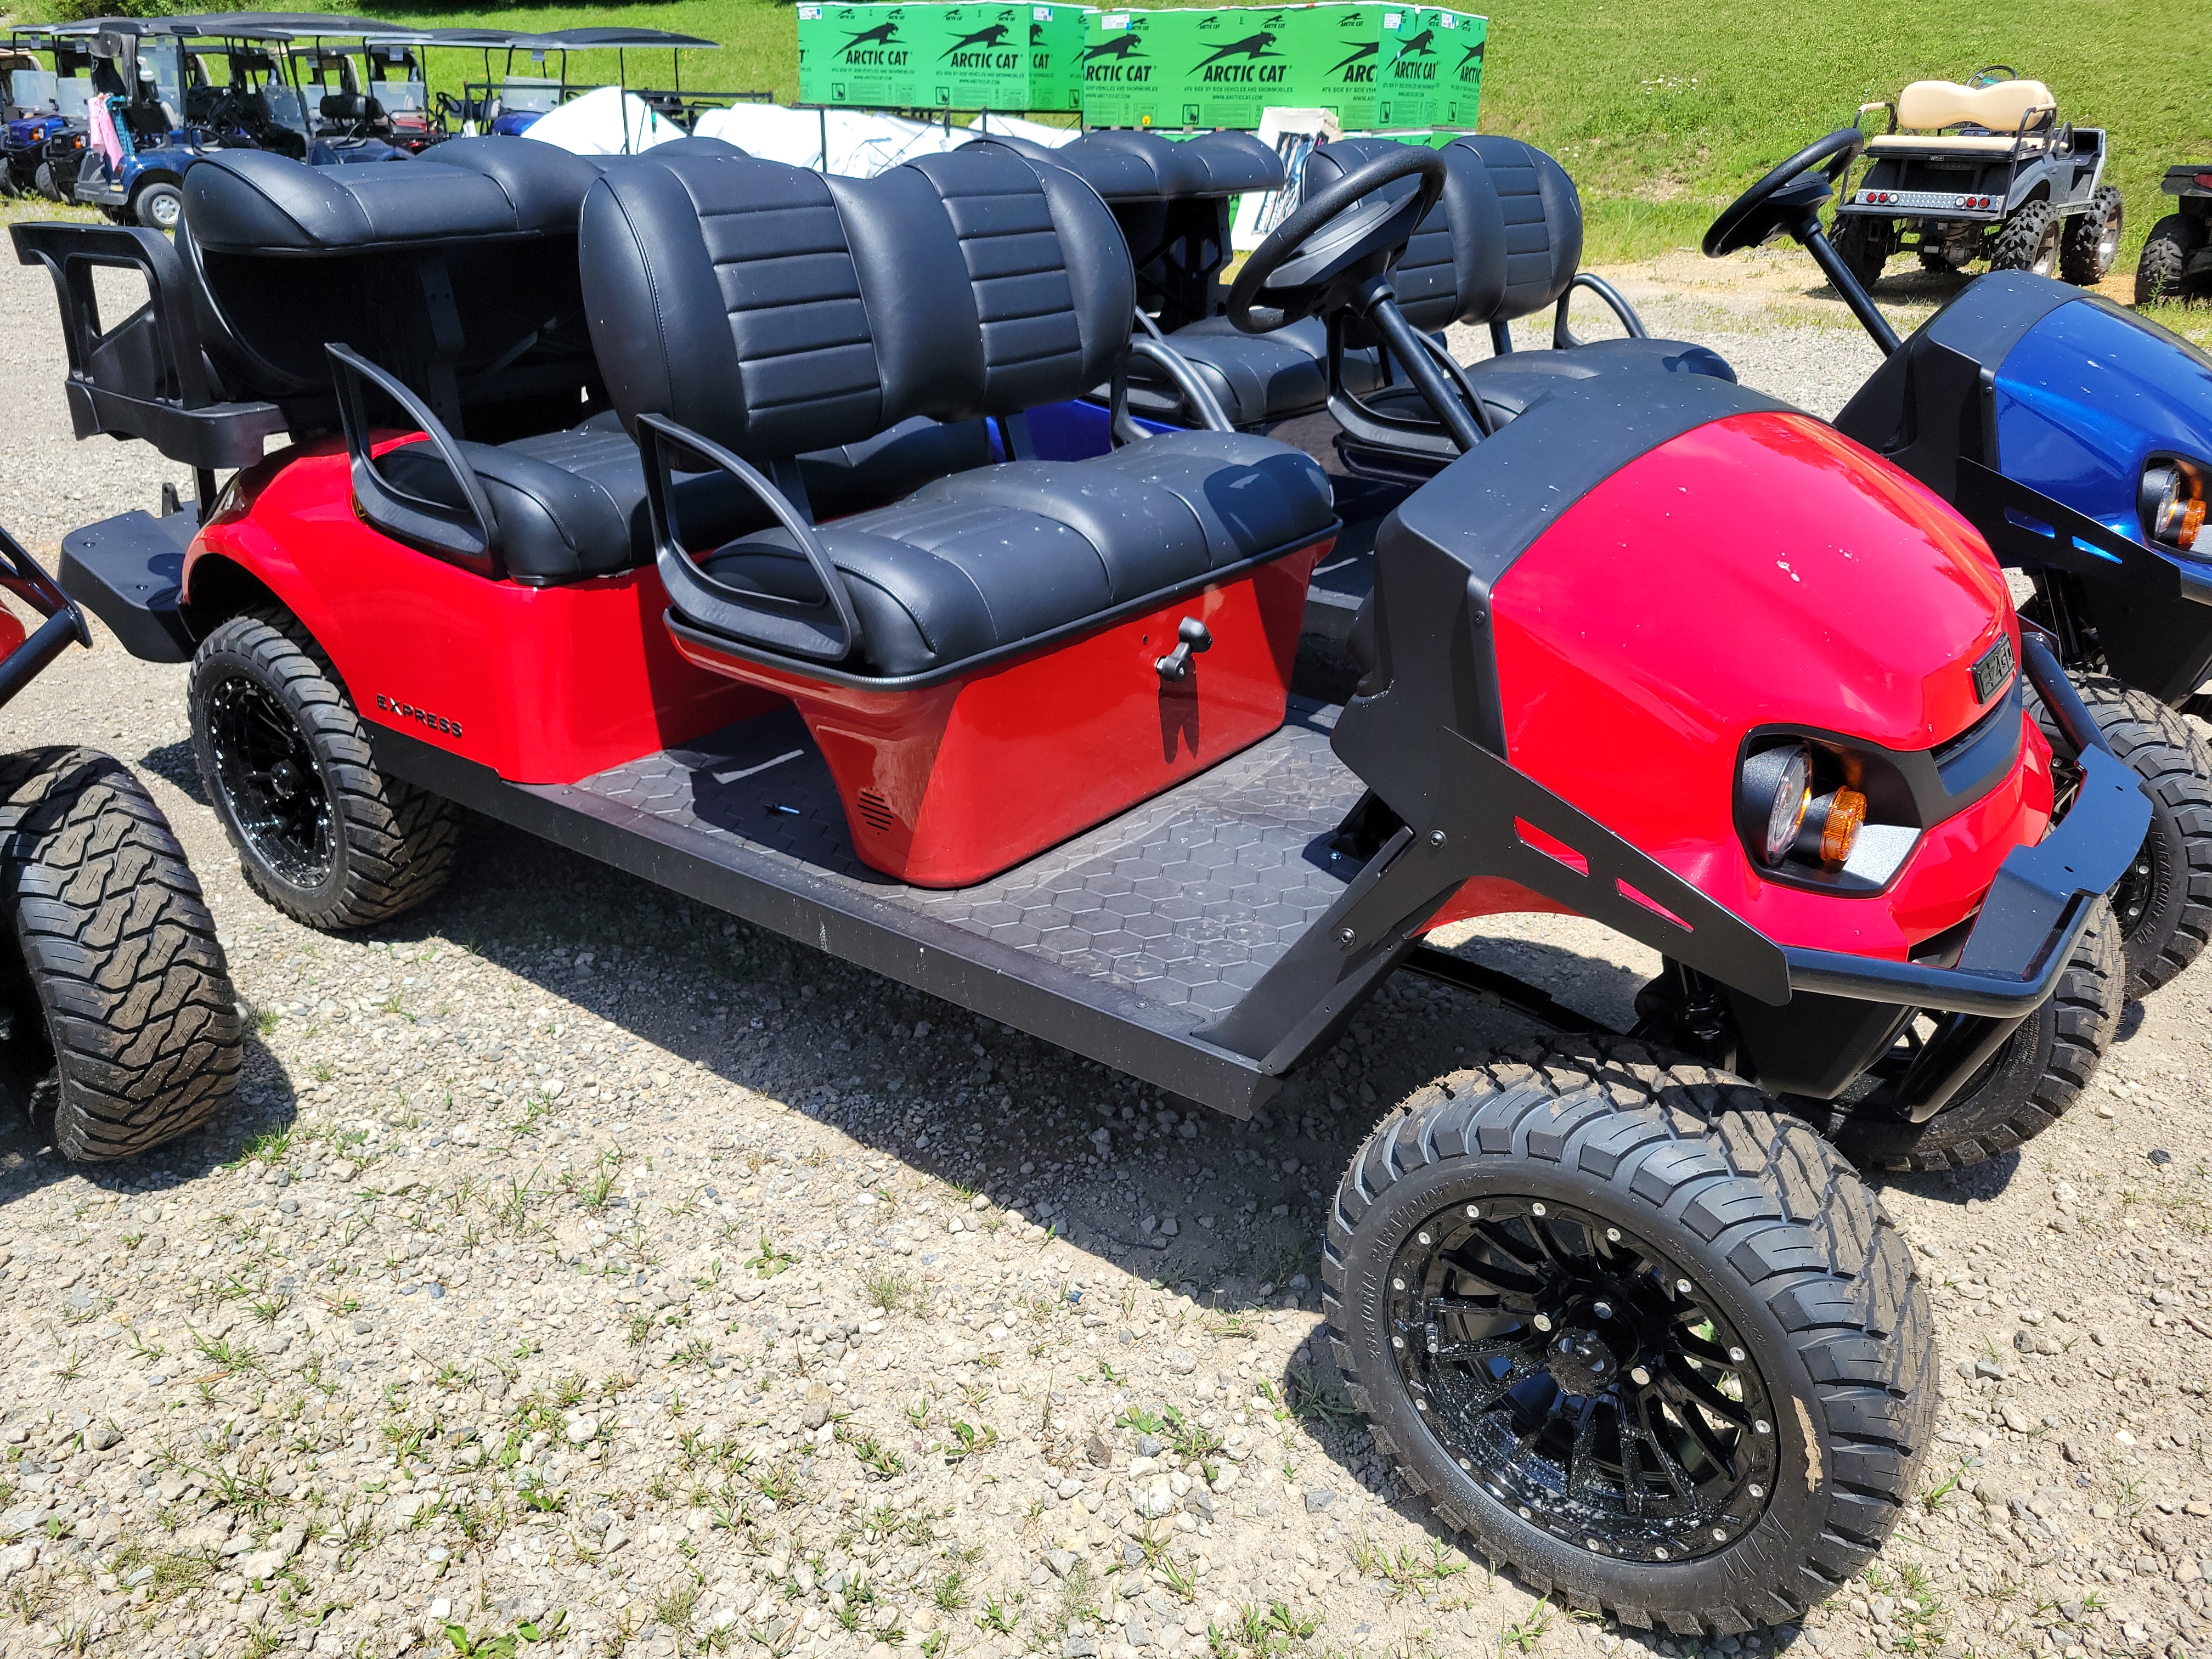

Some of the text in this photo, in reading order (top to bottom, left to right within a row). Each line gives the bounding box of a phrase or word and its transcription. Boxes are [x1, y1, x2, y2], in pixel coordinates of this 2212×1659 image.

[845, 50, 909, 66] ARCTIC CAT
[951, 53, 1018, 69] ARCTIC CAT
[1033, 53, 1049, 69] CAT
[1127, 65, 1152, 82] CAT
[1203, 65, 1287, 82] ARCTIC CAT
[1342, 64, 1378, 82] ARC
[1394, 61, 1438, 80] ARCTIC CAT
[376, 693, 463, 738] EXPRESS
[1369, 1181, 1451, 1265] PARAMOUNT
